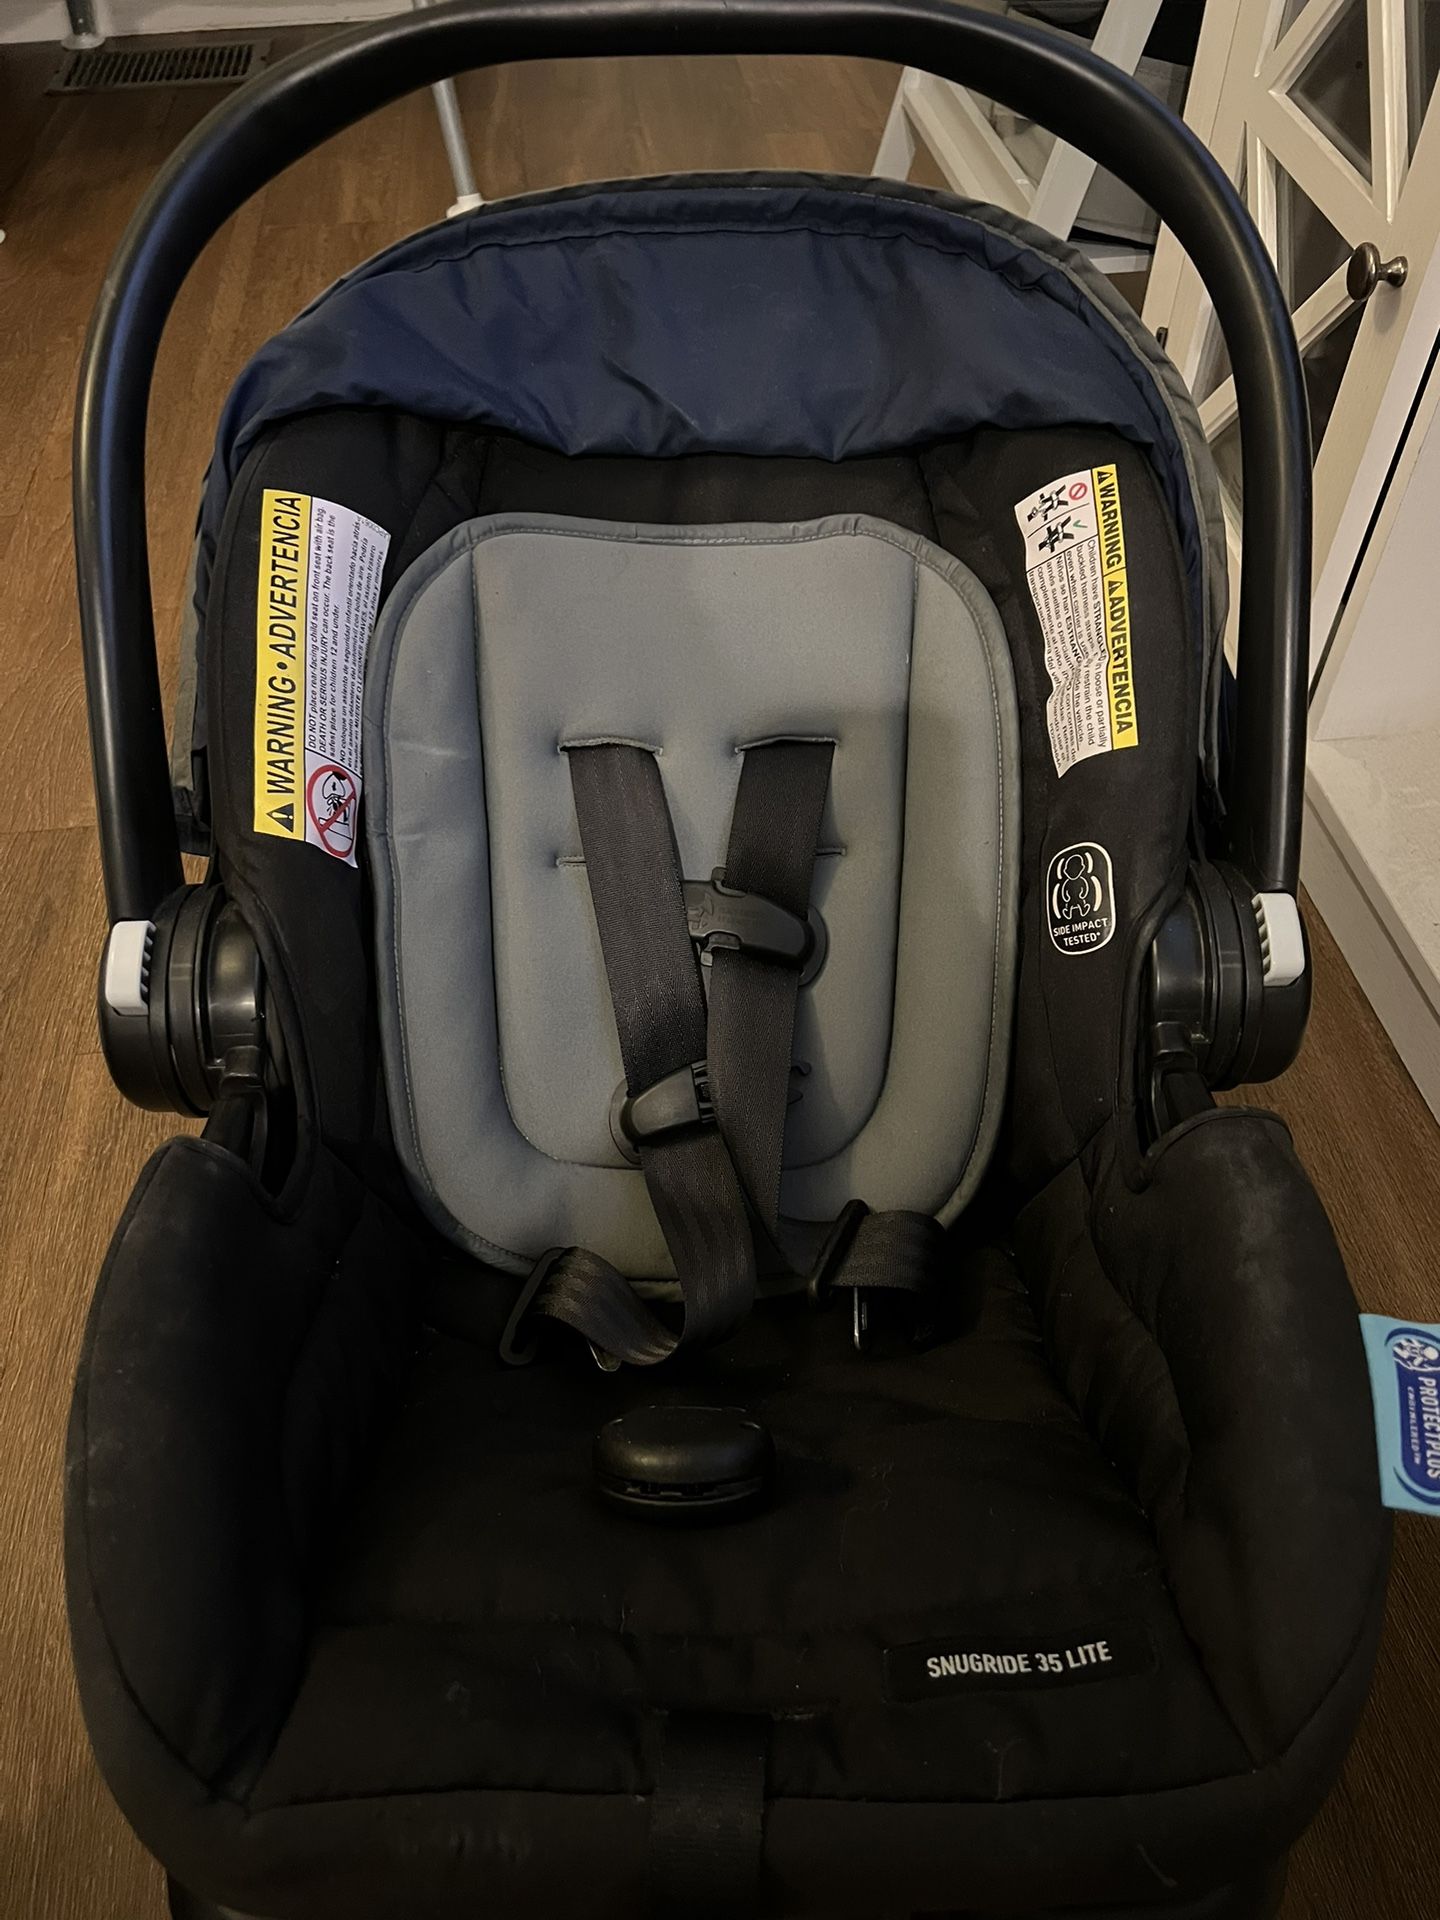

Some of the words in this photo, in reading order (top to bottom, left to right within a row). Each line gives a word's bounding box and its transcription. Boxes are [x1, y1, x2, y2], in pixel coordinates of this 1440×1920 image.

[328, 515, 336, 527] the
[1099, 483, 1122, 569] WARNING
[314, 536, 322, 551] with
[326, 536, 334, 552] seat
[324, 556, 333, 574] back
[1076, 545, 1087, 580] buckled
[1087, 540, 1097, 577] Children
[270, 497, 301, 659] ADVERTENCIA
[312, 571, 320, 590] front
[323, 576, 331, 590] The
[1091, 578, 1100, 600] have
[312, 592, 319, 600] on
[1080, 582, 1090, 618] harness
[310, 622, 318, 642] child
[1094, 601, 1106, 661] STRANGLED
[320, 634, 328, 666] INJURY
[330, 647, 337, 656] 12
[310, 645, 319, 688] rear-facing
[329, 659, 337, 692] children
[342, 664, 349, 675] de
[1109, 596, 1133, 734] ADVERTENCIA
[310, 690, 320, 713] place
[1096, 699, 1103, 708] or
[320, 708, 326, 721] OR
[1085, 706, 1093, 720] the
[267, 676, 296, 794] WARNING
[1087, 723, 1095, 746] child
[1096, 710, 1107, 747] partially
[308, 735, 316, 748] DO
[340, 750, 346, 763] NO
[1054, 925, 1070, 936] SIDE
[1072, 918, 1108, 932] IMPACT
[1418, 1376, 1440, 1478] PROTECTPLUS
[926, 1652, 1032, 1678] SNUGRIDE
[1034, 1652, 1064, 1673] 35
[1065, 1640, 1113, 1669] LITE
